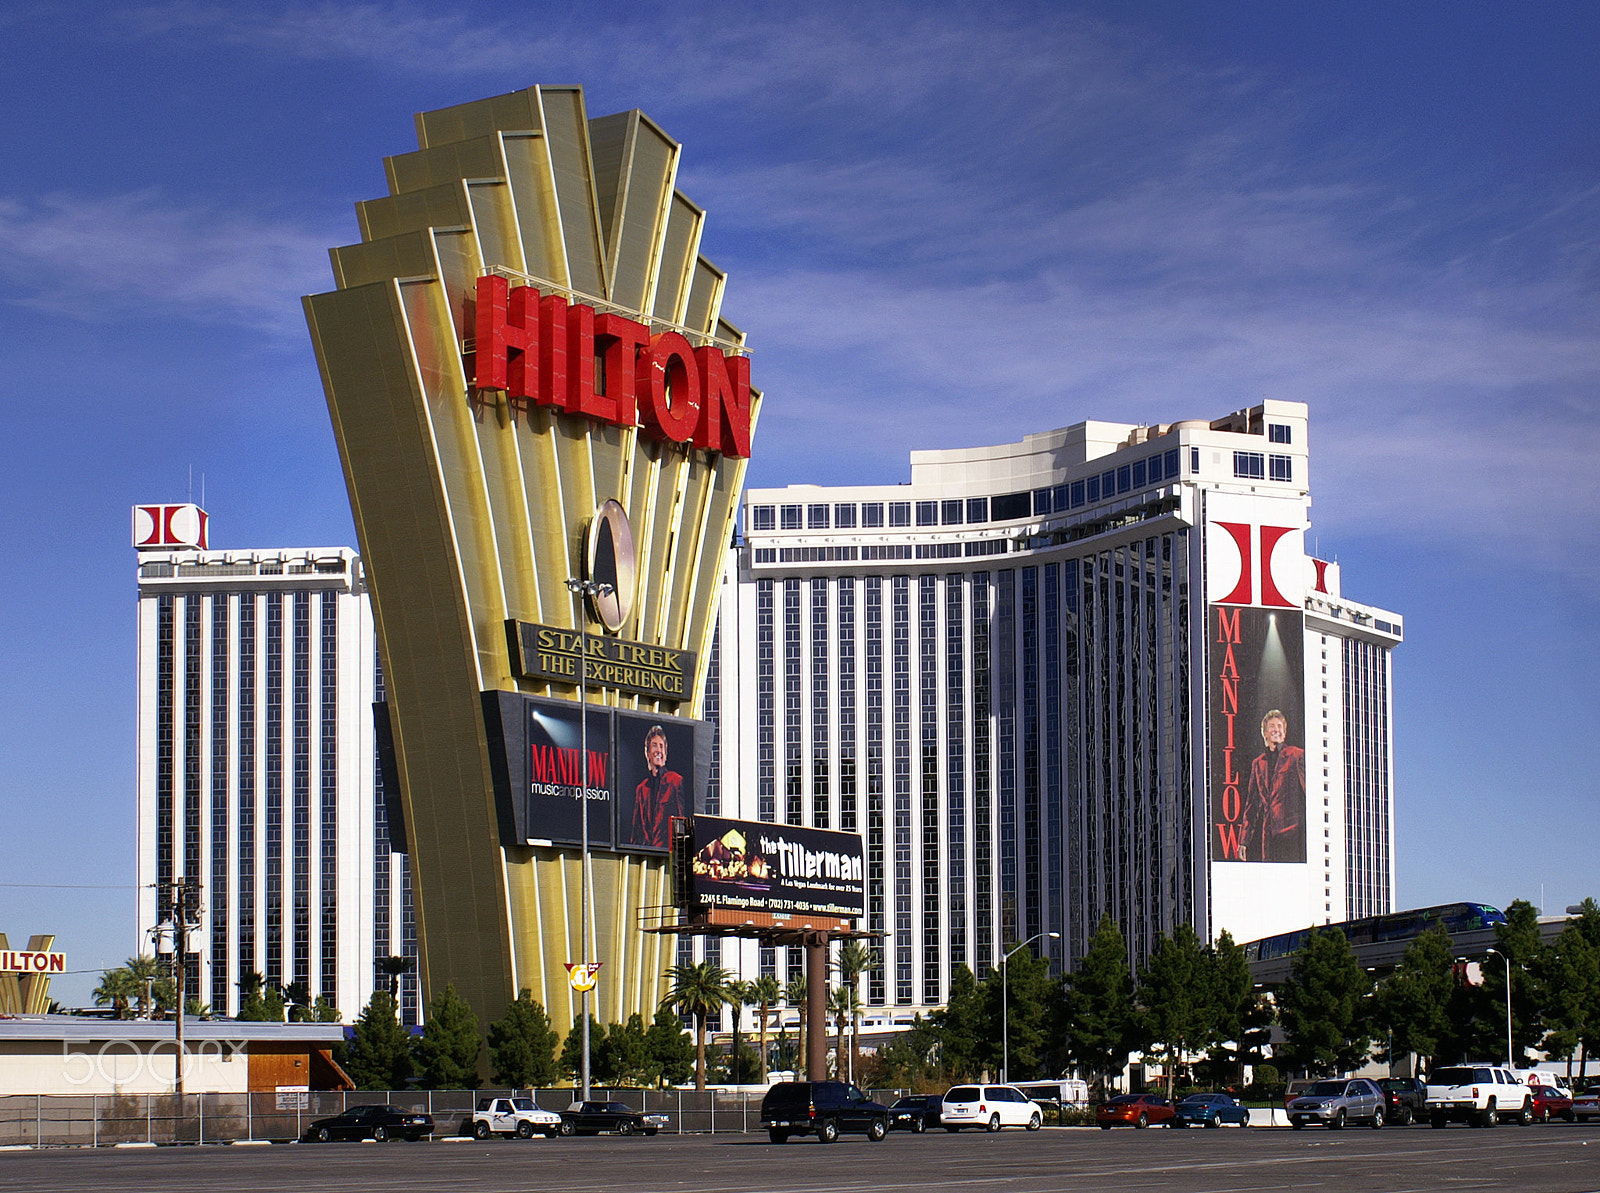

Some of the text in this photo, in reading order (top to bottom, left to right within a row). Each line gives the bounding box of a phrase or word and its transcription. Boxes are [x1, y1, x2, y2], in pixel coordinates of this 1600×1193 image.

[476, 274, 750, 460] HILTON
[538, 629, 682, 671] STAR TREK
[538, 653, 683, 693] THE EXPERIENCE
[1216, 607, 1243, 859] MANILOW
[531, 744, 609, 789] MANILOW
[531, 782, 610, 800] musicandpssion
[759, 835, 777, 855] the
[785, 879, 793, 887] Las
[794, 880, 806, 889] Vegas
[722, 894, 749, 908] Flamingo
[749, 896, 765, 908] Road
[768, 898, 783, 910] (702)
[812, 902, 863, 915] www.tillerman.com
